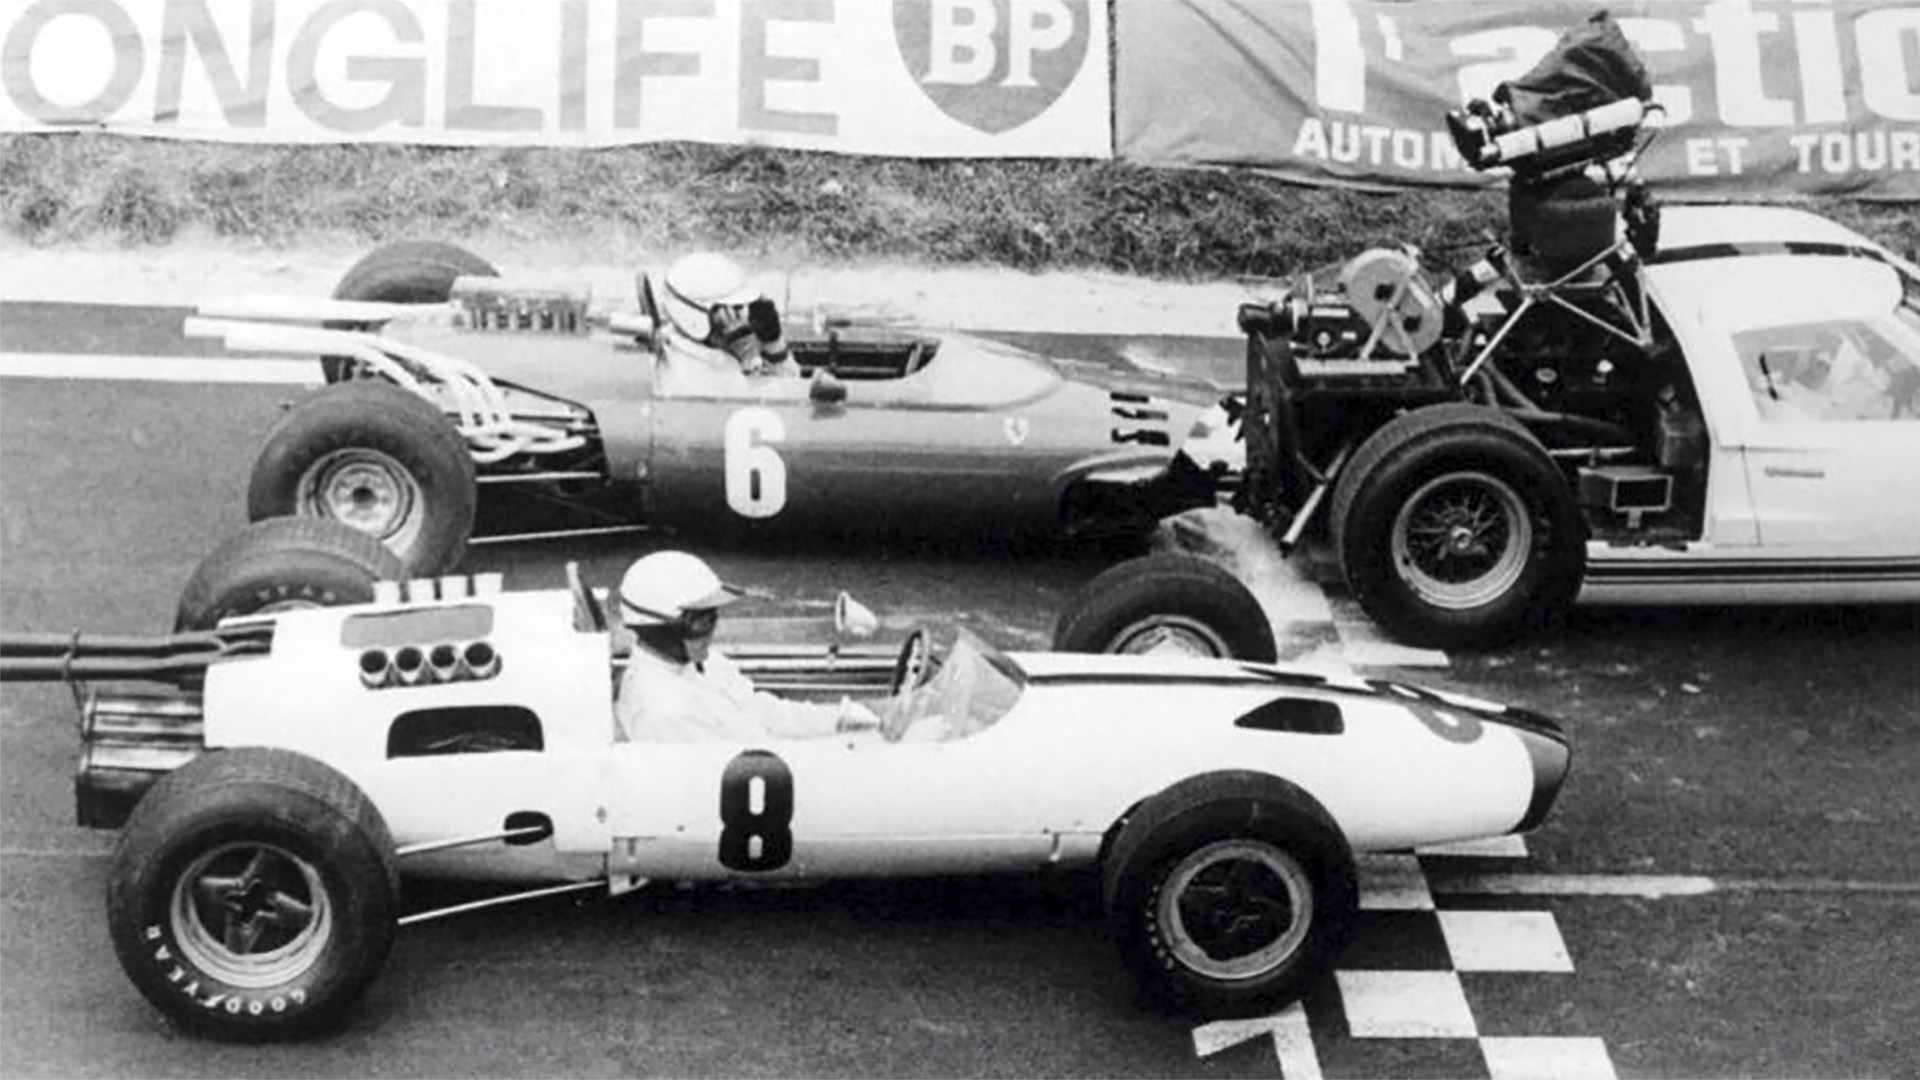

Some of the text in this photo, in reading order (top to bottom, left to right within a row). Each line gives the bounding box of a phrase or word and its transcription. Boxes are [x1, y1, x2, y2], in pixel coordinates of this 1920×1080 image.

[2, 0, 839, 135] ONGLIFE
[920, 0, 1074, 86] BP
[1294, 117, 1920, 176] AUTOM ET TOUR
[724, 406, 786, 518] 6
[718, 749, 794, 872] 8
